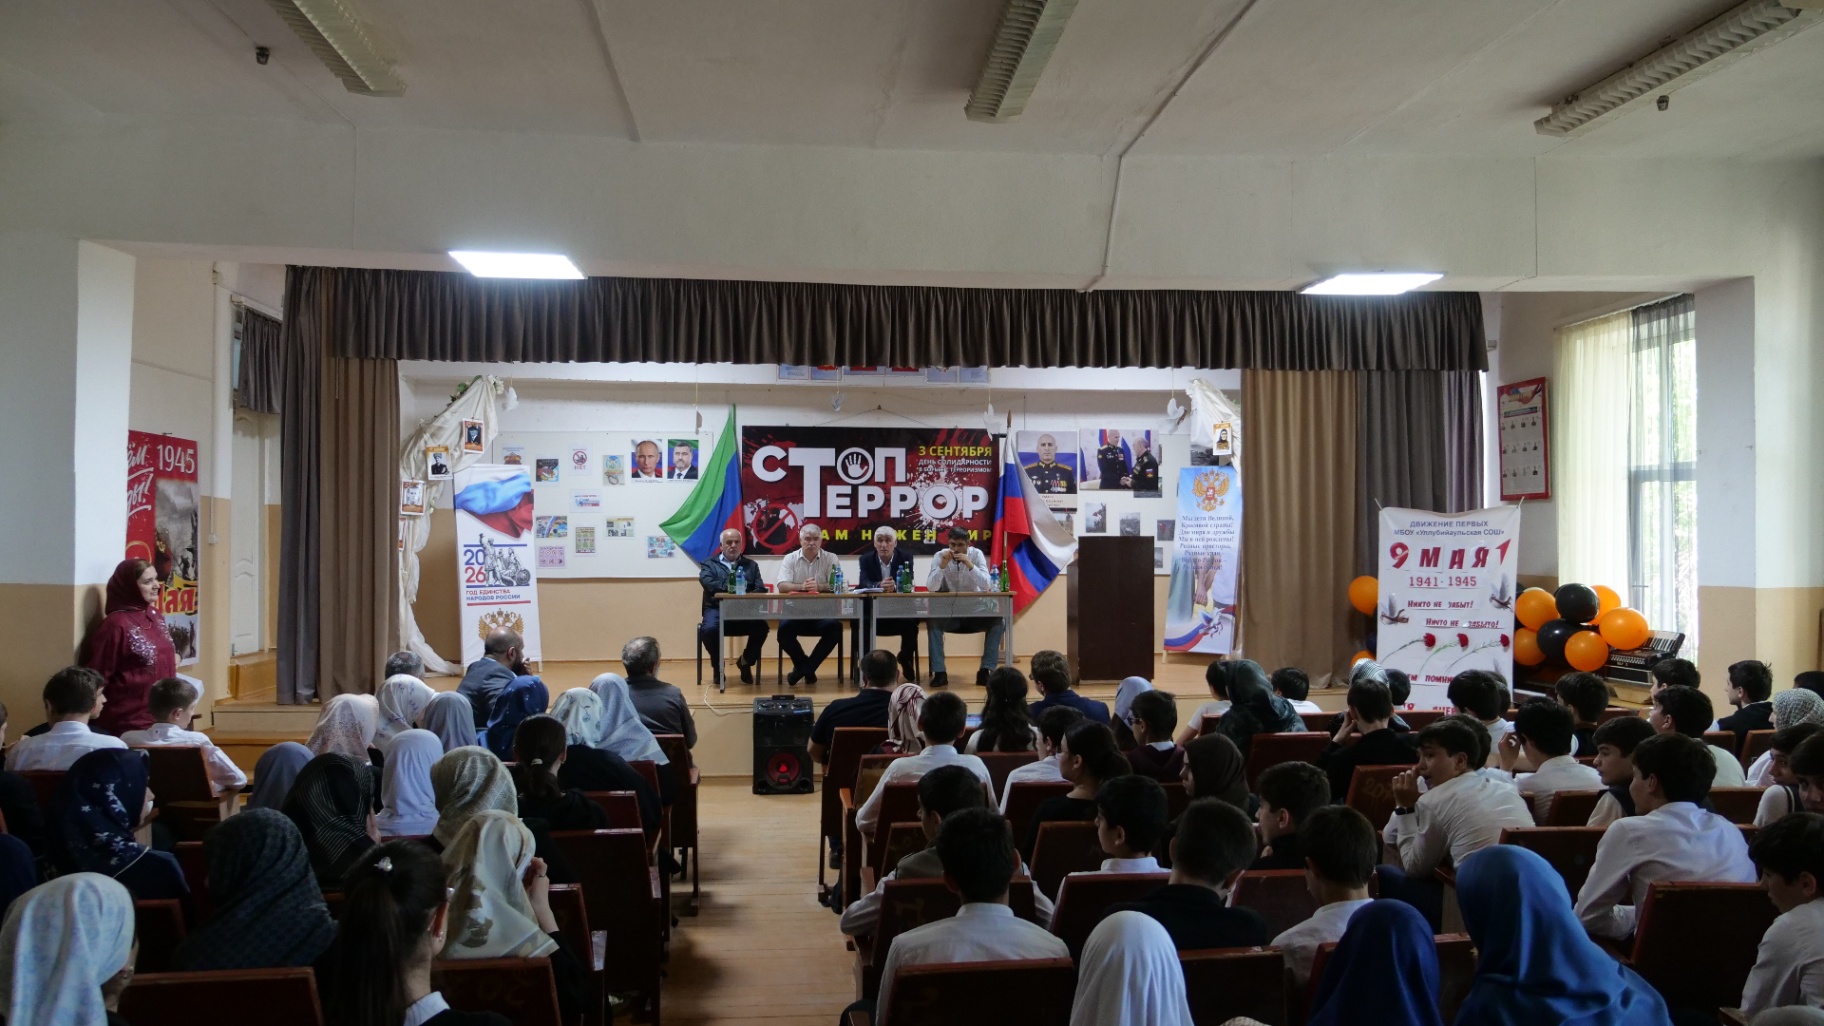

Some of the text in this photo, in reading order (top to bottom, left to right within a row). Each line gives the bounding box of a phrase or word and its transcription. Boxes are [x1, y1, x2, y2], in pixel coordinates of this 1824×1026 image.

[919, 446, 992, 456] 3 СЕНТЯБРЯ
[157, 444, 196, 474] 1945
[1409, 520, 1453, 528] ДВИЖЕНИЕ
[821, 529, 992, 541] АМ НЖЕН ИР
[464, 549, 486, 566] 20
[1389, 541, 1490, 570] 9 МАЯ
[465, 566, 487, 583] 26
[1407, 673, 1455, 683] ЕМ ПОМНИ
